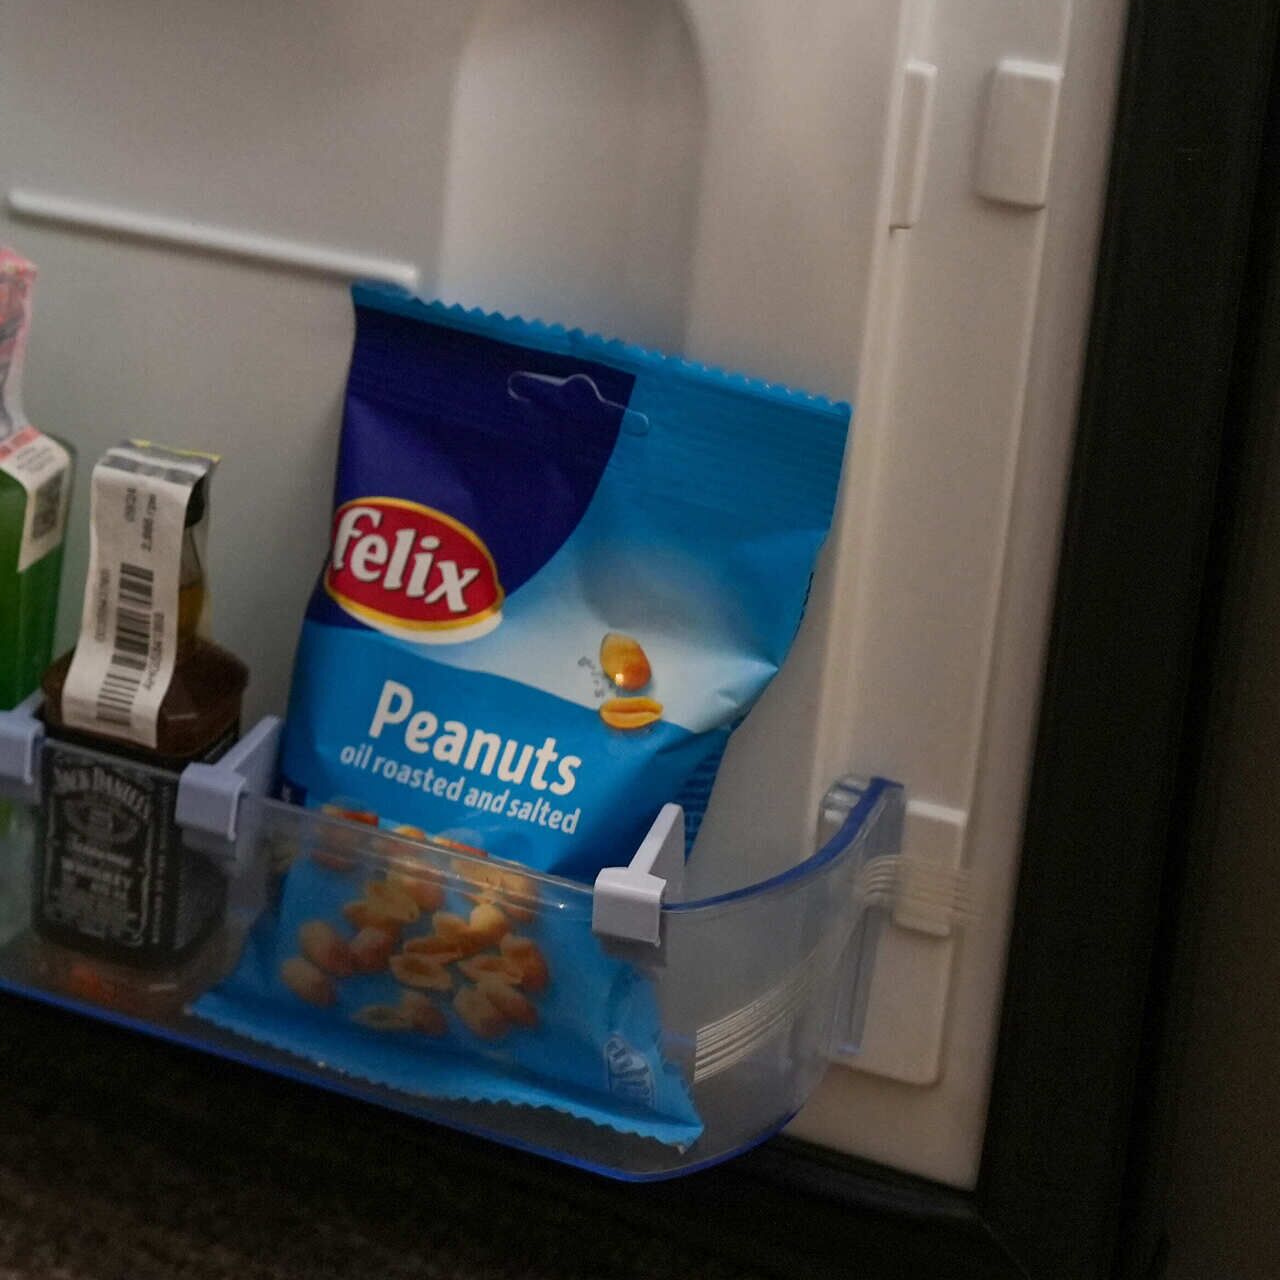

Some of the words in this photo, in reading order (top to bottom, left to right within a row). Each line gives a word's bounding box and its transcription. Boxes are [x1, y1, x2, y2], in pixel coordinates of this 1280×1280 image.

[340, 743, 373, 770] oil
[371, 755, 466, 803] roasted
[463, 786, 510, 815] and
[506, 797, 582, 835] salted
[368, 679, 582, 796] Peanuts
